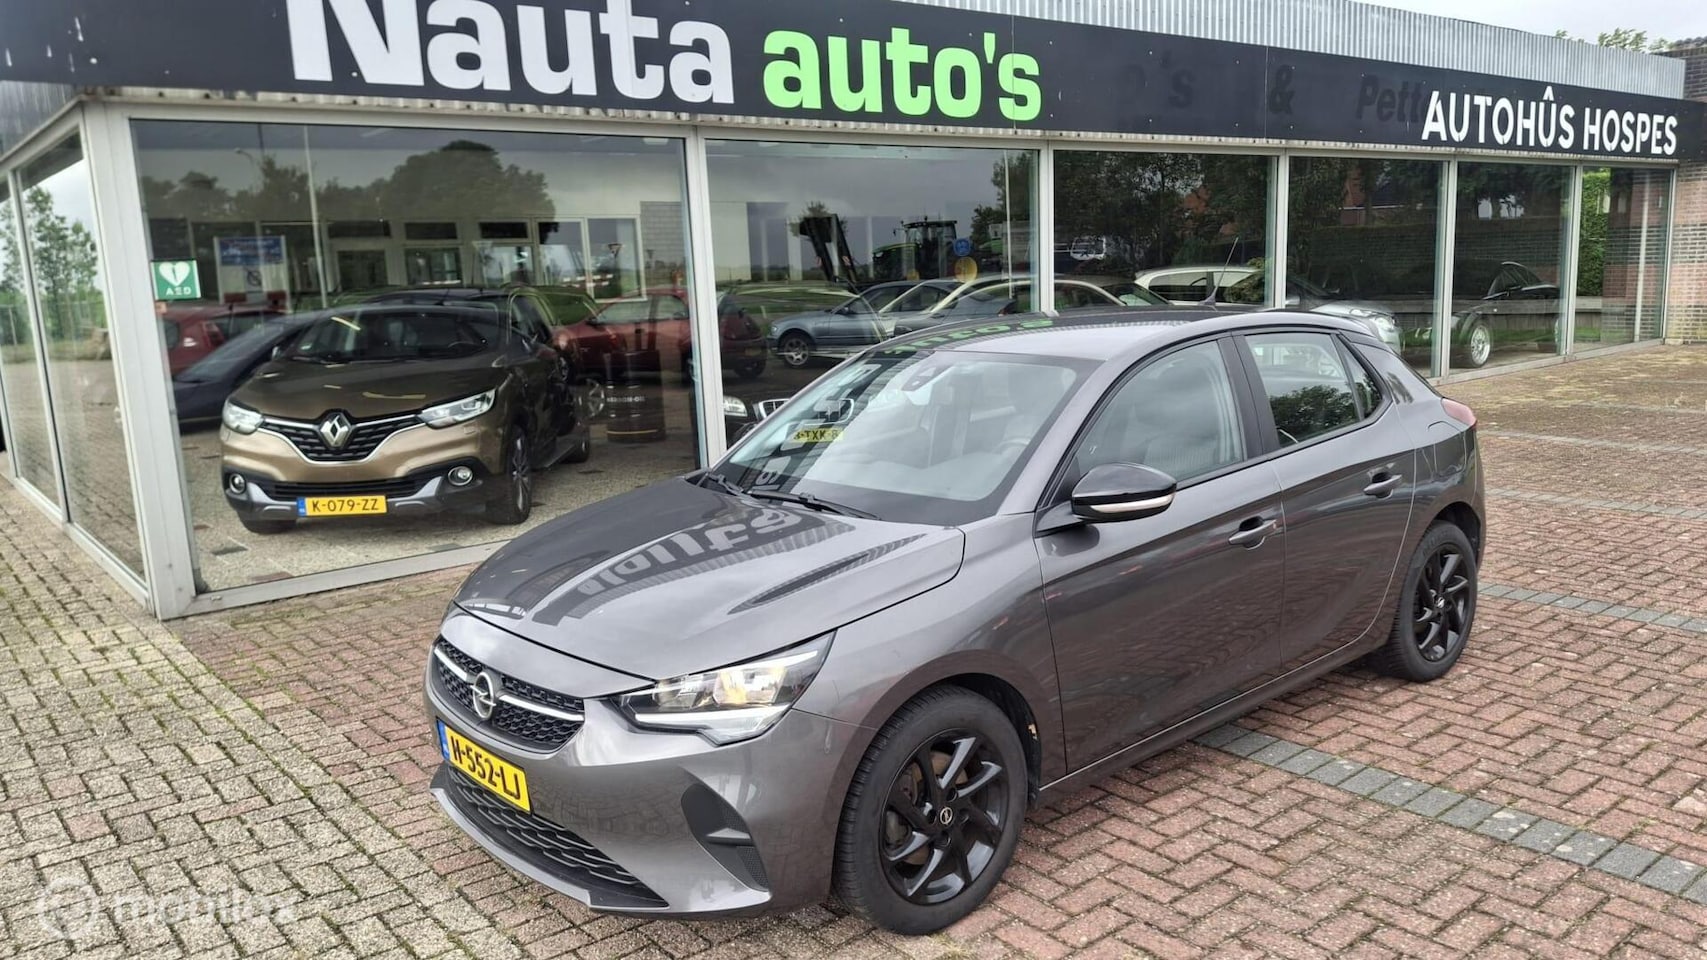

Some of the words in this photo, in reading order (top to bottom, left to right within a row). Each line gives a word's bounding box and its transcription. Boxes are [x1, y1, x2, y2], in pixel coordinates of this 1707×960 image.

[286, 0, 735, 104] Nauta
[763, 27, 1042, 121] auto's
[1421, 85, 1575, 149] AUTOHÛS
[1583, 107, 1678, 155] HOSPES
[166, 286, 192, 296] AED
[311, 498, 379, 512] K-079-ZZ
[450, 735, 521, 800] H-552-LJ
